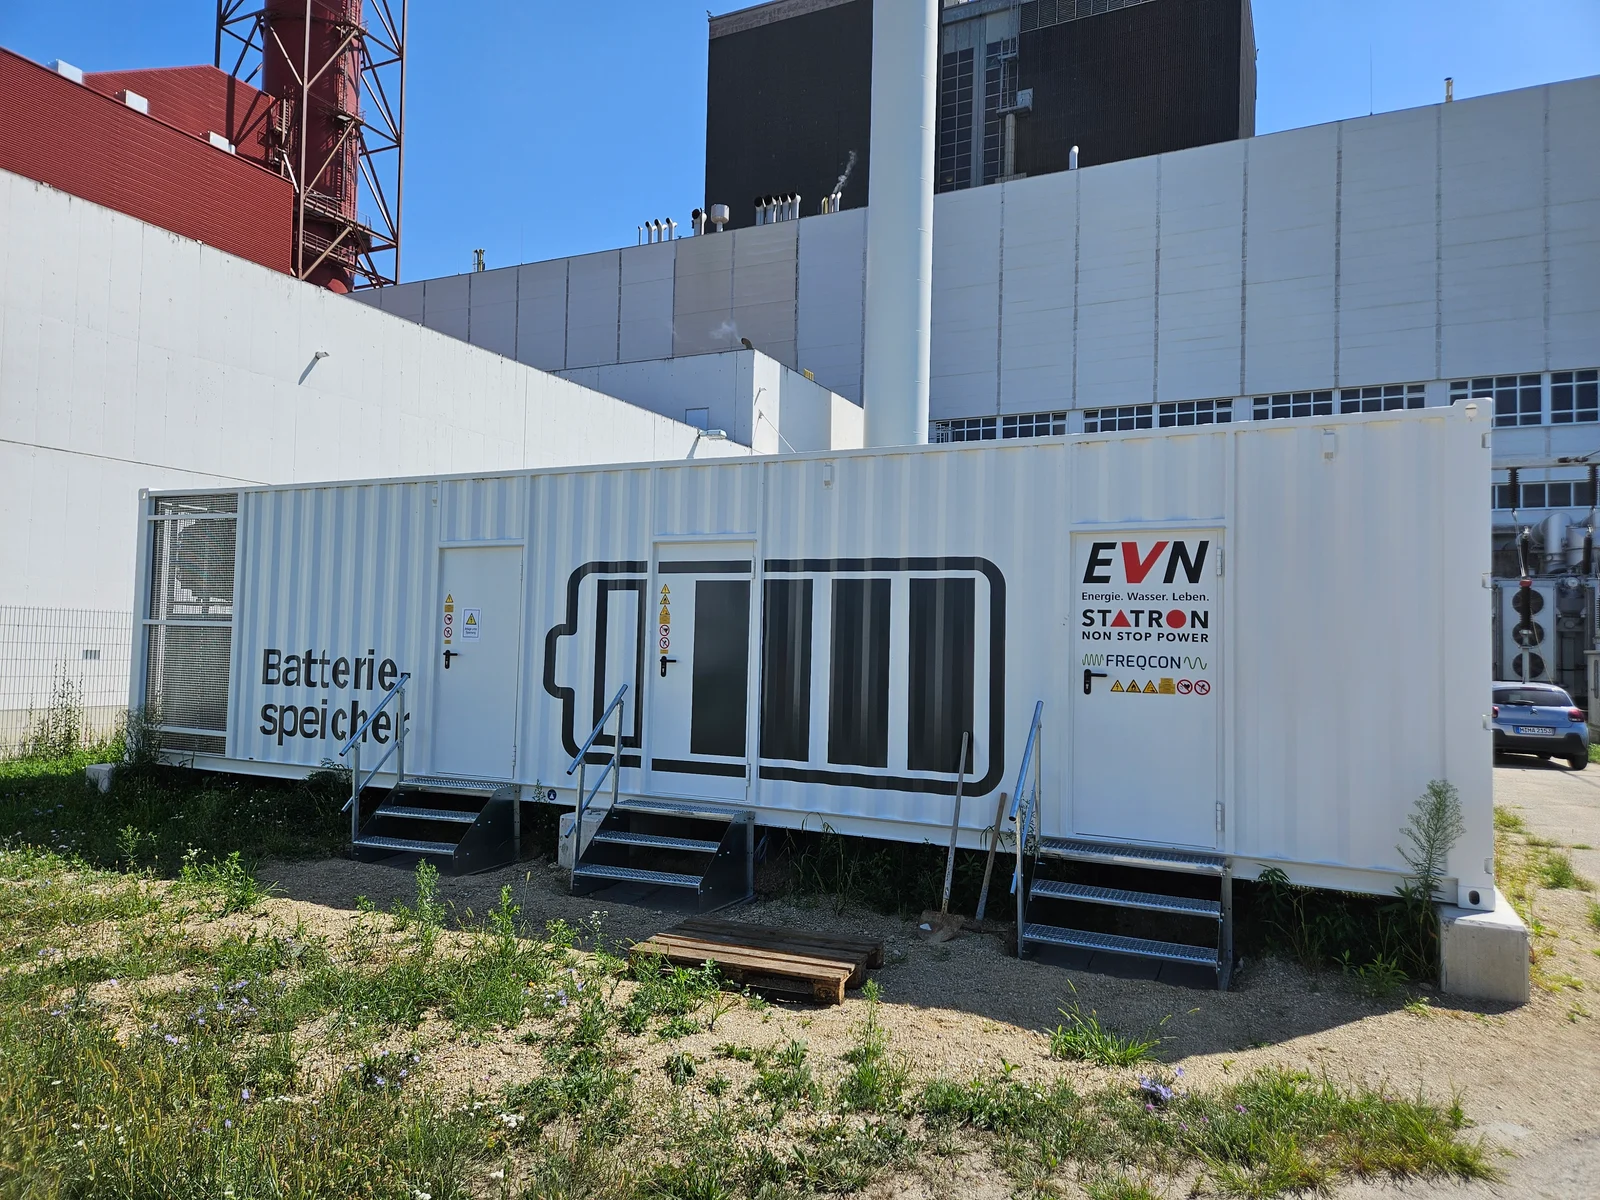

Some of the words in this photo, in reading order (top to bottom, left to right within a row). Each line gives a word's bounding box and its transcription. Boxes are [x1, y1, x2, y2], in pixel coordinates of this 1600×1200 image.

[1083, 540, 1209, 584] EVN
[1081, 591, 1124, 603] Energie.
[1127, 592, 1169, 601] Wasser.
[1172, 591, 1210, 602] Leben.
[1081, 608, 1209, 629] STATRON
[1082, 631, 1112, 641] NON
[1117, 632, 1152, 641] STOP
[1157, 633, 1209, 643] POWER
[1106, 654, 1181, 670] FREQCON
